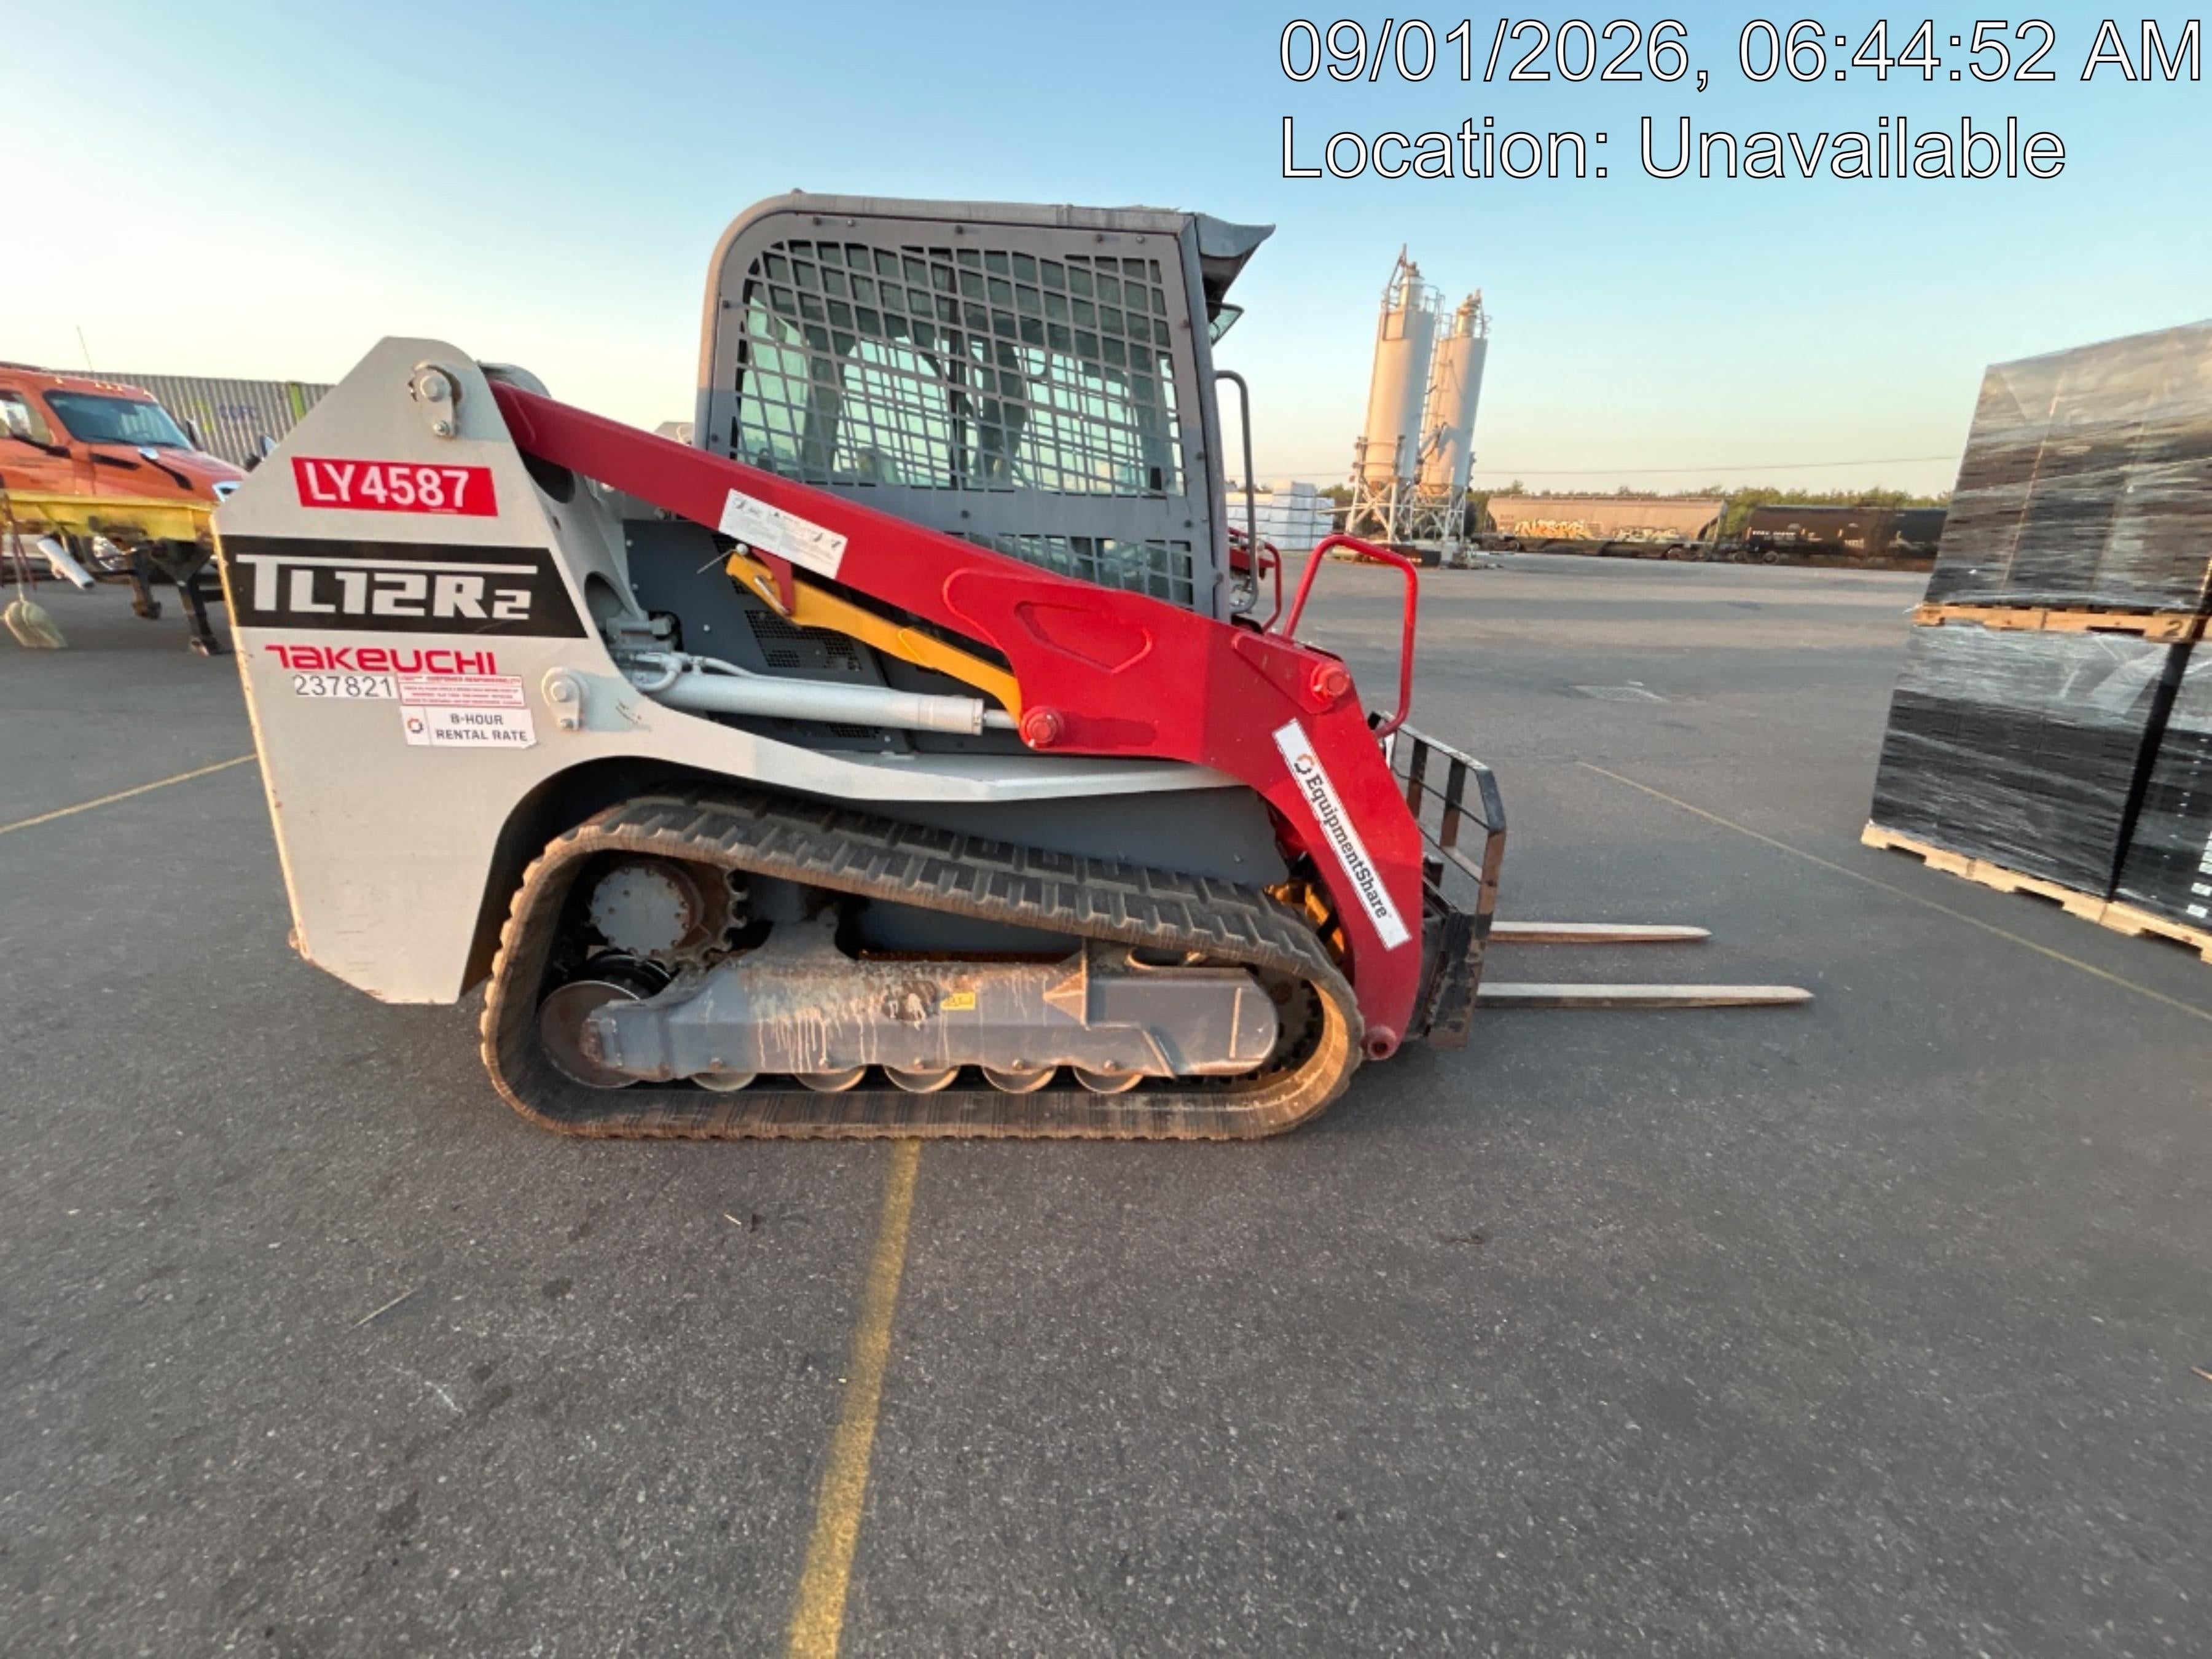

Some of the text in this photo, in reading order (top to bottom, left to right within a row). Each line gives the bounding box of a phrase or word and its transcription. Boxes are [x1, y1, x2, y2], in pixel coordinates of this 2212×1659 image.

[305, 462, 469, 508] LY4587
[293, 675, 392, 697] 237821
[436, 729, 527, 741] RENTAL RATE
[1305, 774, 1387, 919] EquipmentShare
